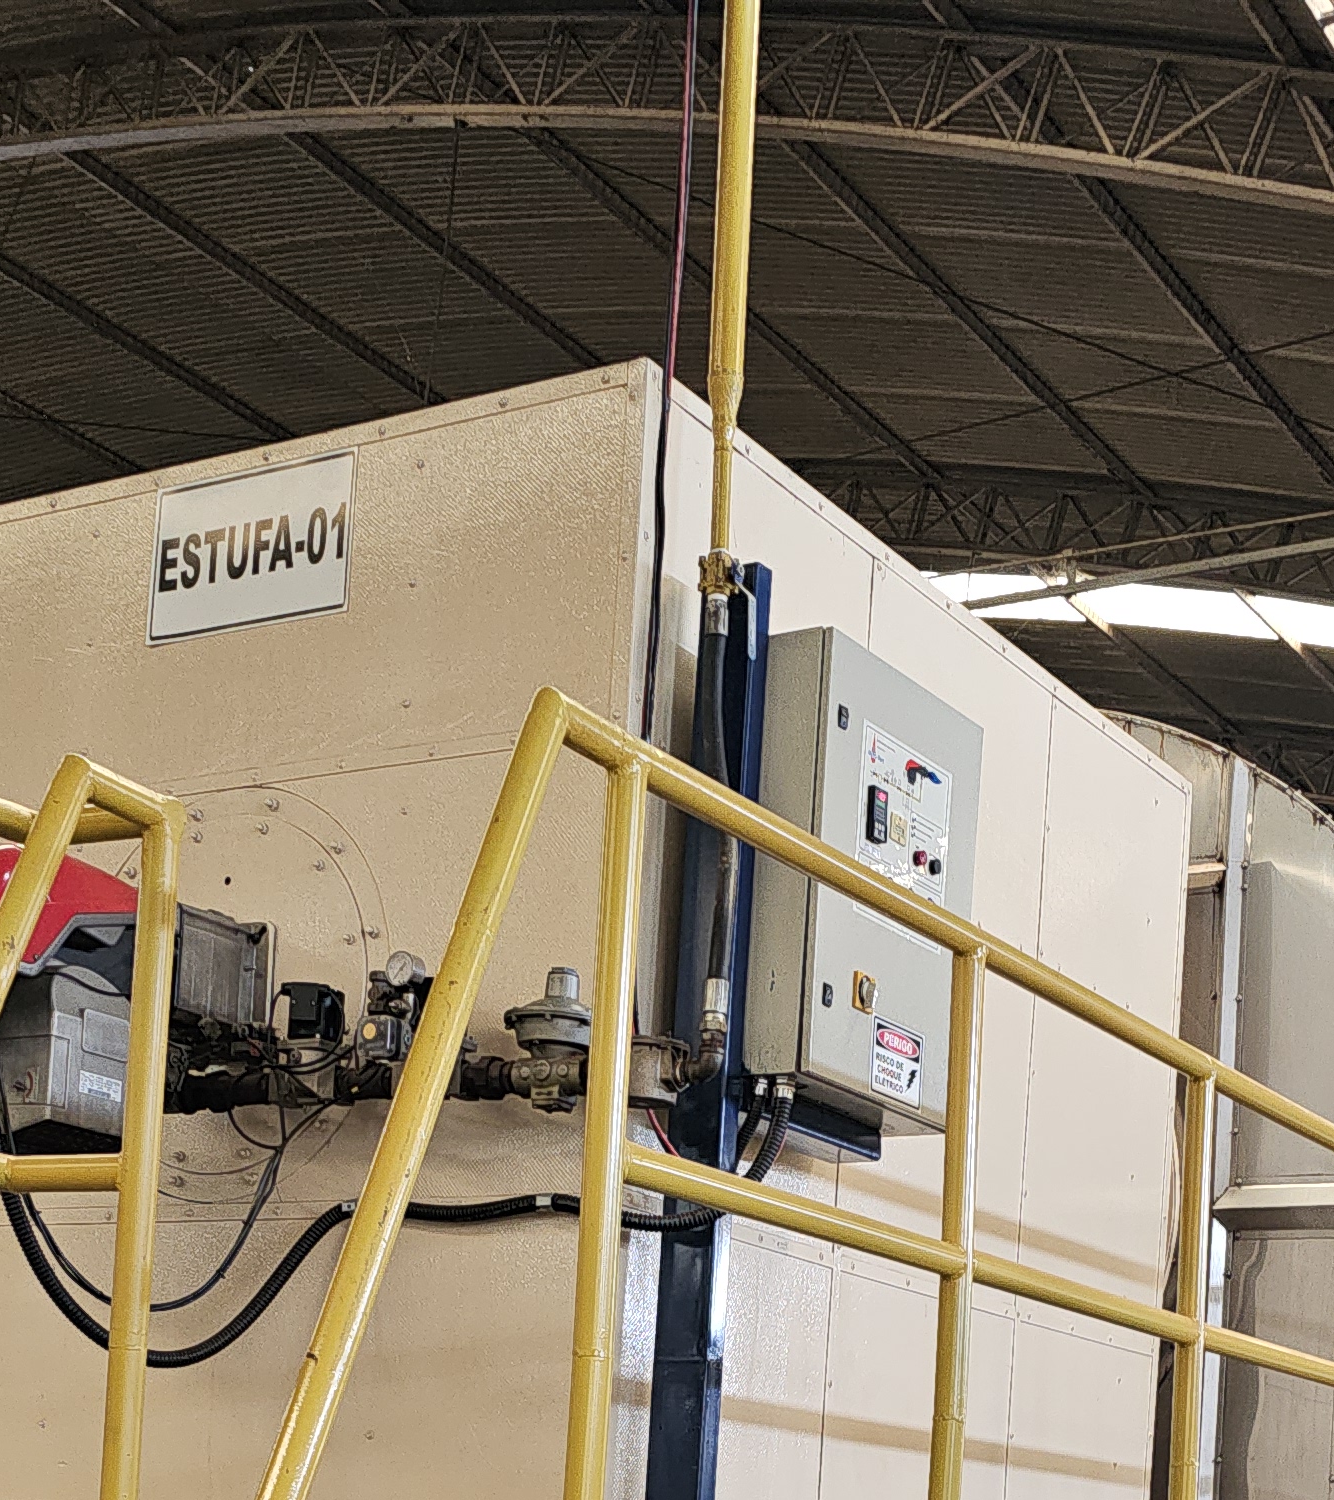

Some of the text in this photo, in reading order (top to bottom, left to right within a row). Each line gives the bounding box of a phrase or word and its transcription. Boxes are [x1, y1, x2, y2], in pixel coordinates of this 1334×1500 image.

[158, 502, 347, 593] ESTUFA-01
[883, 1032, 913, 1055] PERIGO
[876, 1052, 905, 1072] RISCO DE
[877, 1064, 902, 1082] CHOQUE
